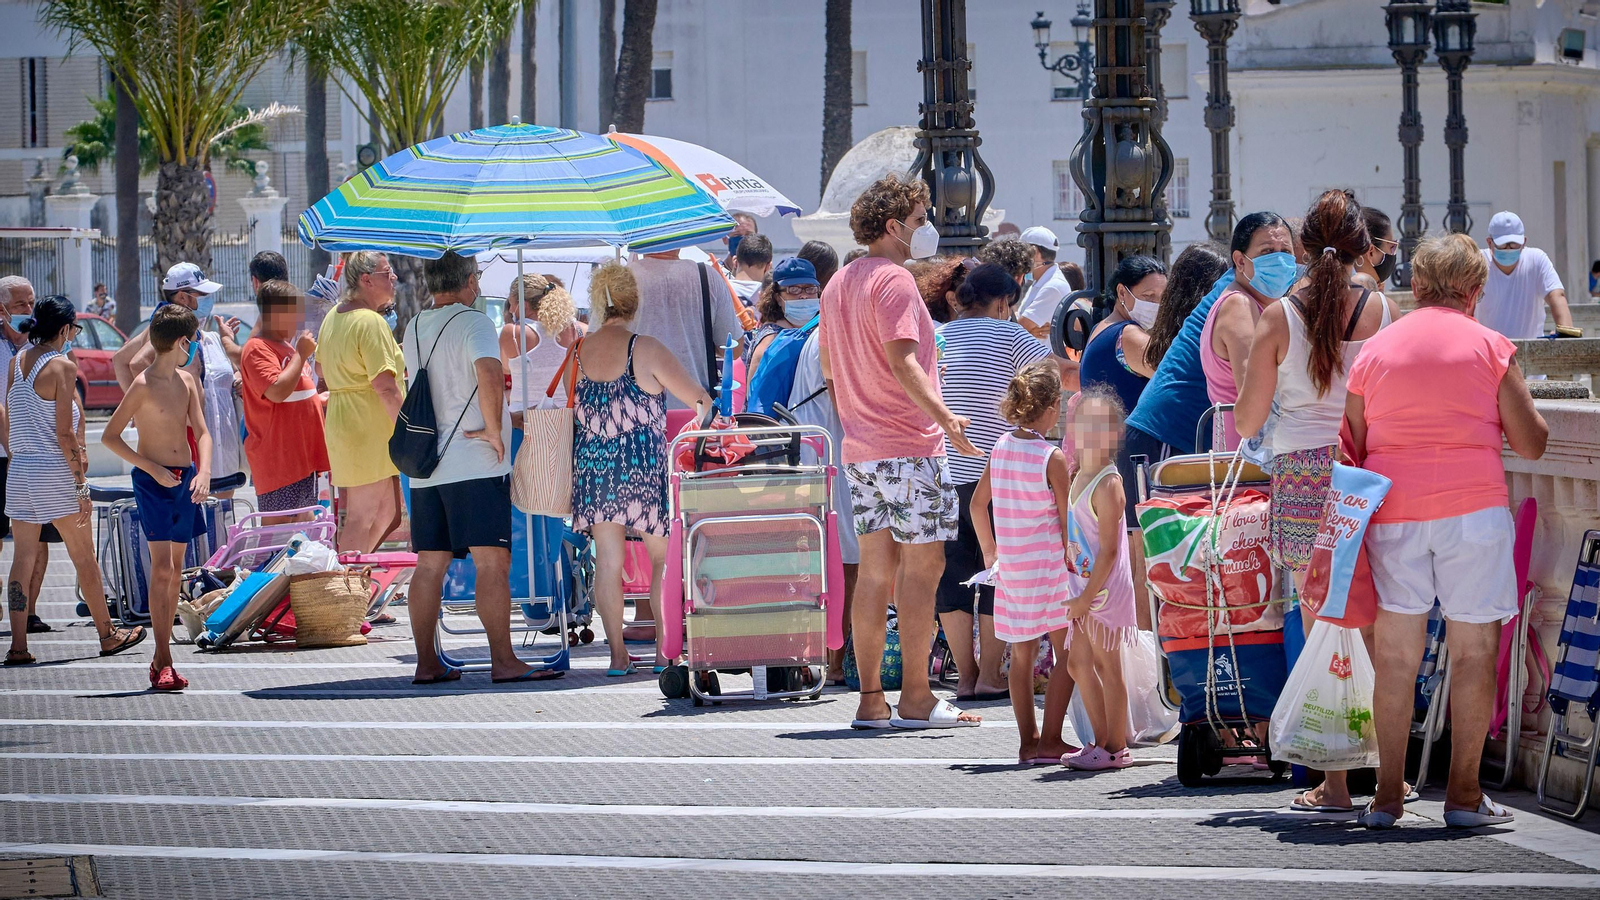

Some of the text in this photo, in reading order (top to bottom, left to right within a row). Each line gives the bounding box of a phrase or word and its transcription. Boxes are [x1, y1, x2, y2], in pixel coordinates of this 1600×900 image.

[719, 176, 765, 190] Pinta
[1328, 489, 1368, 509] ou are
[1222, 515, 1231, 531] I
[1232, 512, 1258, 528] love
[1224, 551, 1260, 573] much
[1303, 702, 1335, 716] REUTILIZA
